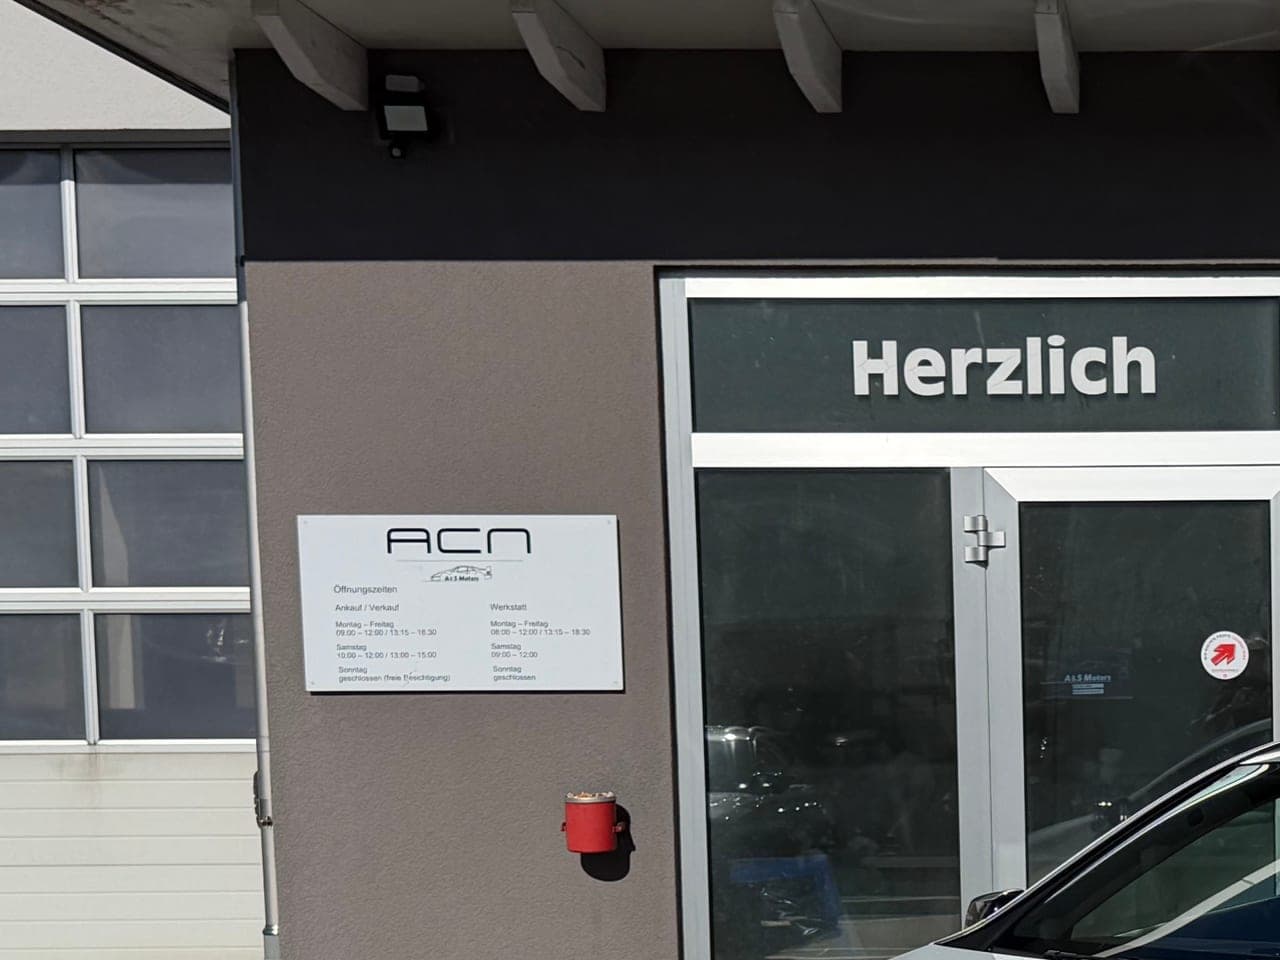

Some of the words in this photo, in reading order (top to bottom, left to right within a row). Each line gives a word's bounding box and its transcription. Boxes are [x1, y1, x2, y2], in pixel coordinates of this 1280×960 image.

[852, 334, 1156, 396] Herzlich
[387, 528, 531, 554] ACN
[333, 585, 398, 595] Öffnungszeiten
[490, 603, 527, 611] Werkstatt
[335, 621, 362, 629] Montag
[370, 621, 394, 629] Freitag
[490, 620, 516, 628] Montag
[524, 620, 549, 628] Freitag
[336, 643, 367, 651] Samstag
[491, 643, 522, 651] Samstag
[338, 666, 368, 674] Sonntag
[493, 665, 522, 673] Sonntag
